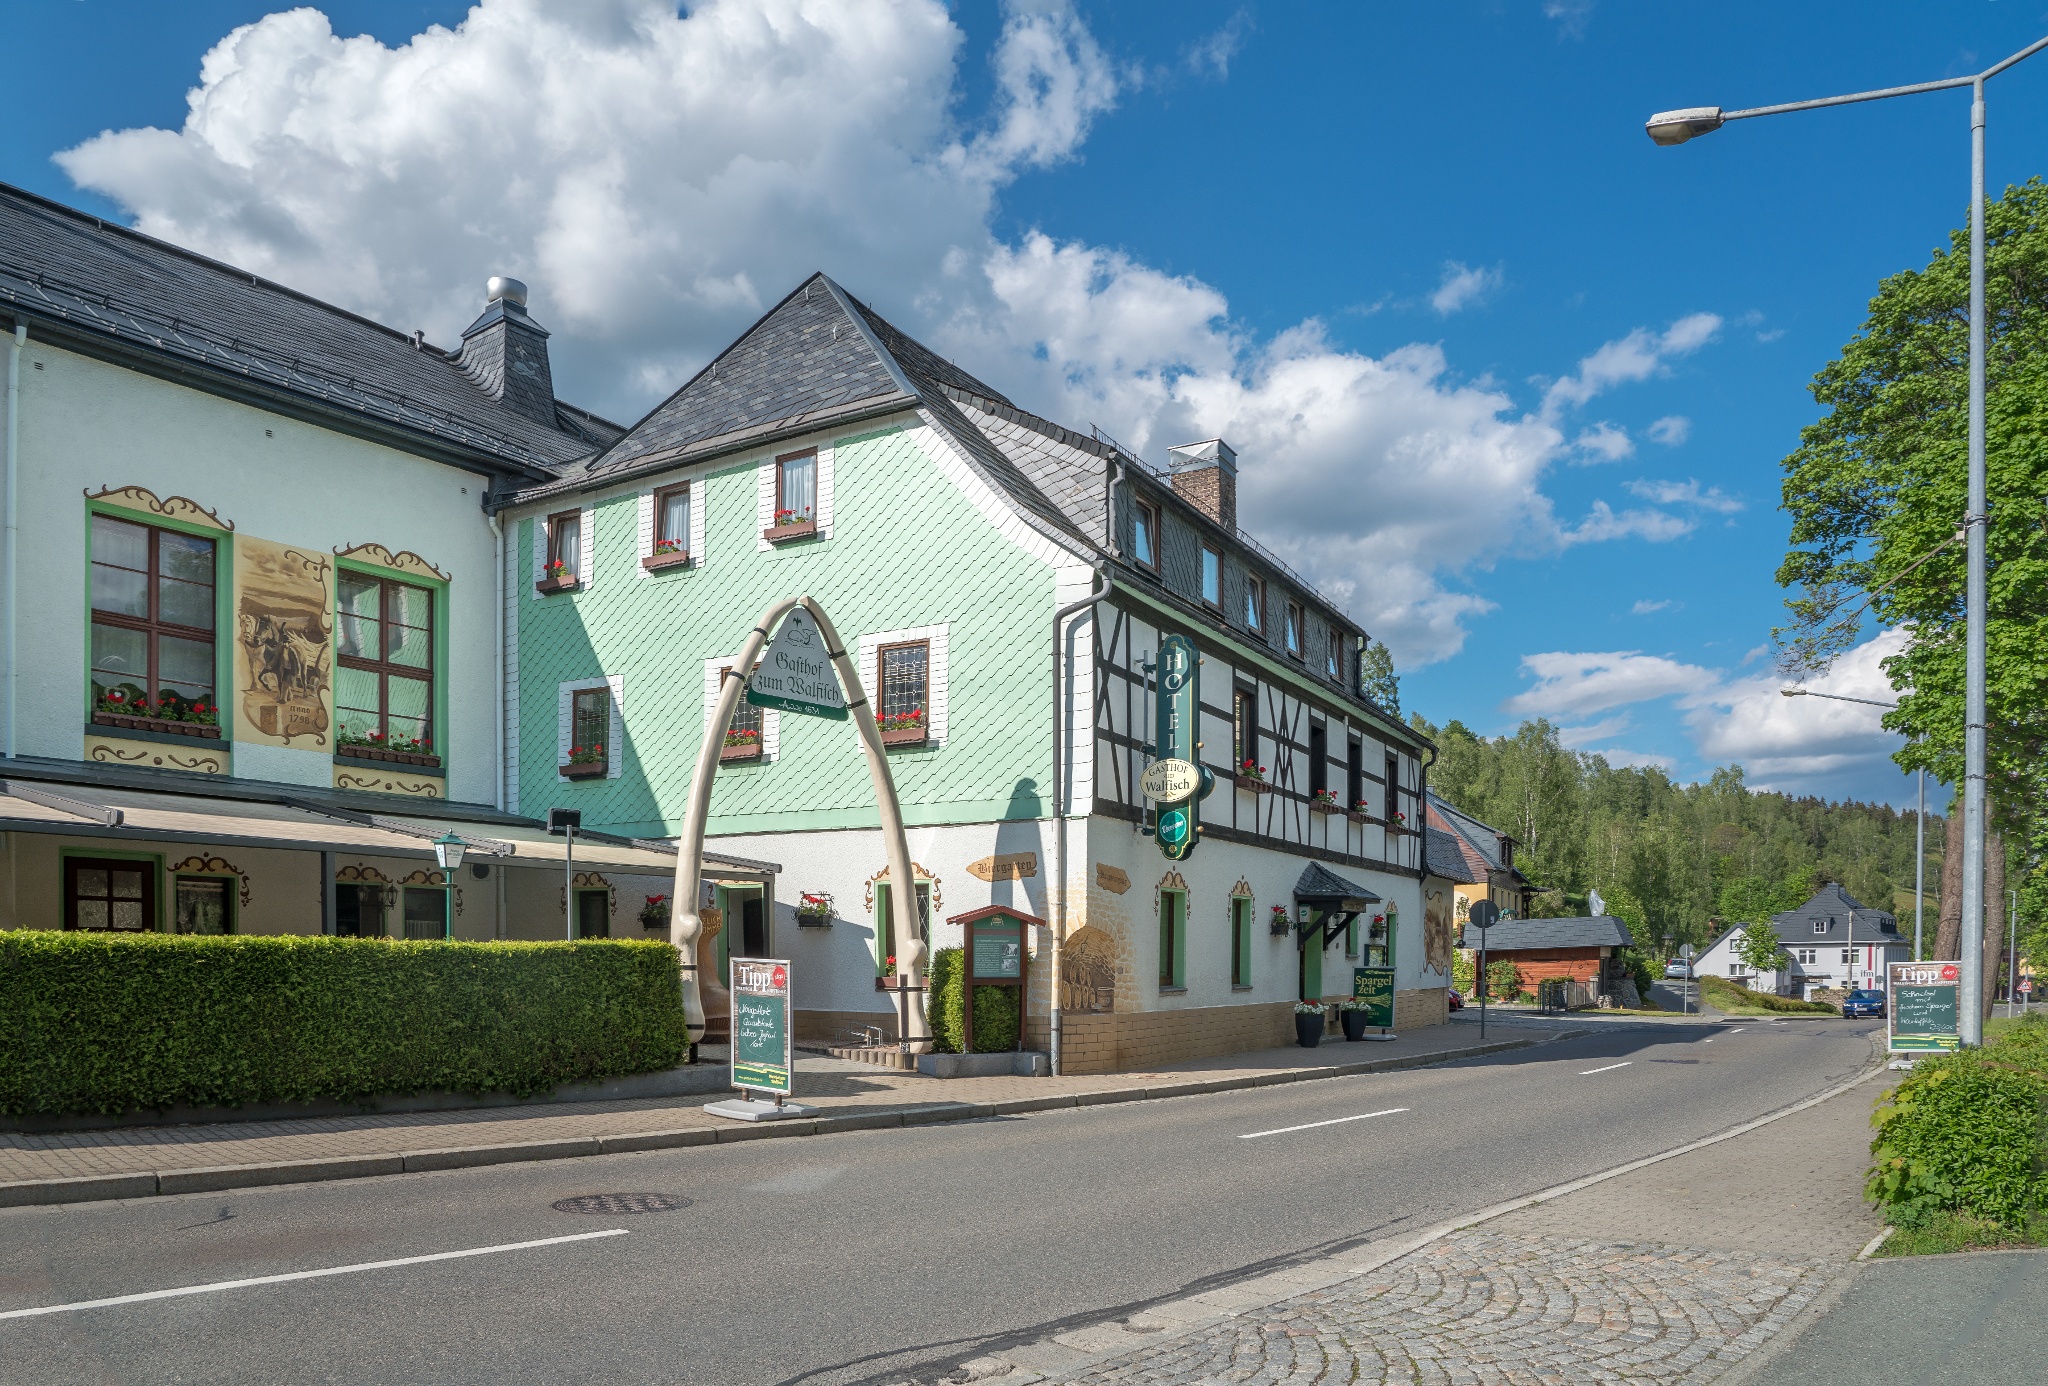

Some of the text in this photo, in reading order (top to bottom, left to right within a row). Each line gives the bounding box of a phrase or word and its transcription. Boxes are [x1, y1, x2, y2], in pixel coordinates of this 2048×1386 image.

[757, 675, 784, 692] zum
[1164, 653, 1183, 750] HOTEL
[1148, 763, 1189, 777] GASTHOF
[1145, 778, 1190, 792] Walfisch
[977, 860, 1032, 874] Biergarten
[738, 965, 771, 993] Tipp
[1860, 969, 1874, 977] ifm
[1897, 967, 1939, 985] Tipp
[1355, 975, 1392, 988] Spargel
[1358, 985, 1376, 994] zeit
